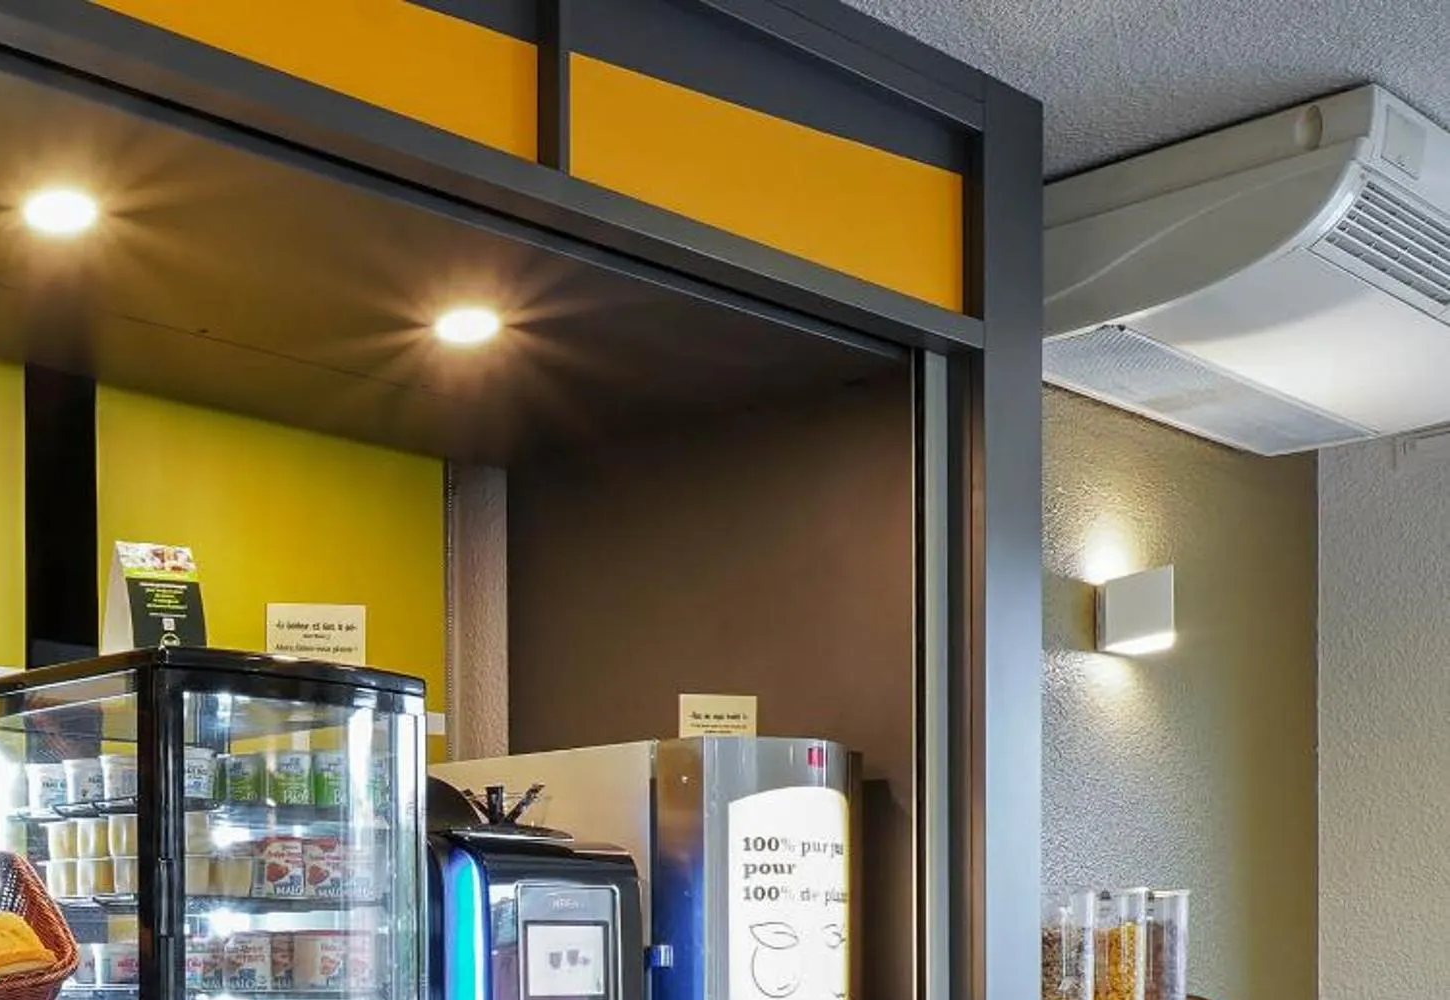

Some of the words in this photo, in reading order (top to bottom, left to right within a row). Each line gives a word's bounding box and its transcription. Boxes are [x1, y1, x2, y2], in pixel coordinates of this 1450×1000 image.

[743, 836, 796, 854] 100%
[742, 863, 796, 880] pour
[743, 886, 796, 902] 100%
